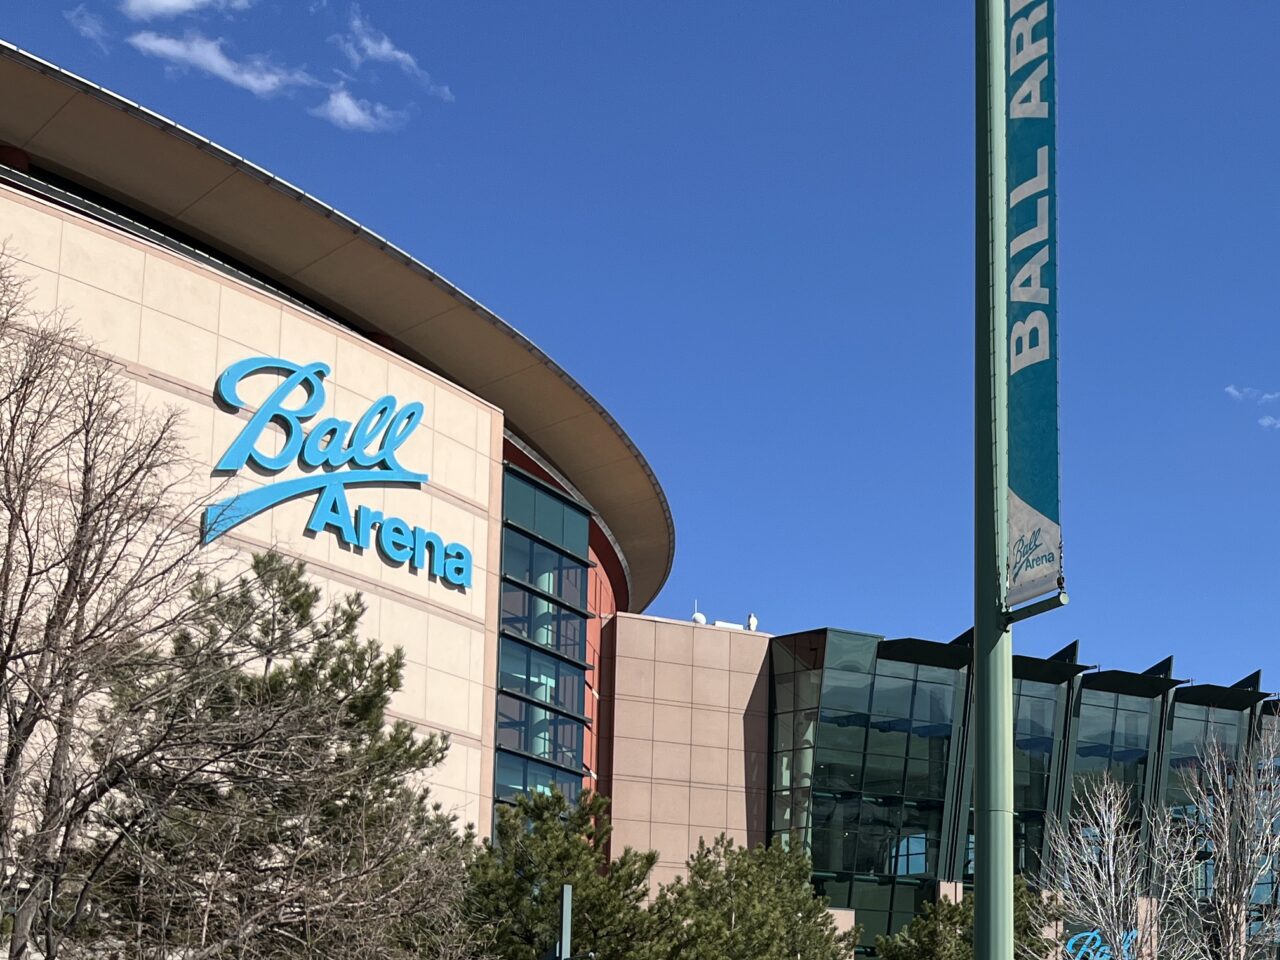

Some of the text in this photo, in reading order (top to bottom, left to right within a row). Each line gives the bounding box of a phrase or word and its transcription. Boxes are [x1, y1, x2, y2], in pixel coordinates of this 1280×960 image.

[1010, 145, 1050, 376] BALL
[215, 357, 427, 482] Ball
[306, 482, 472, 588] Arena
[1013, 528, 1042, 567] Ball
[1024, 552, 1055, 571] Arena
